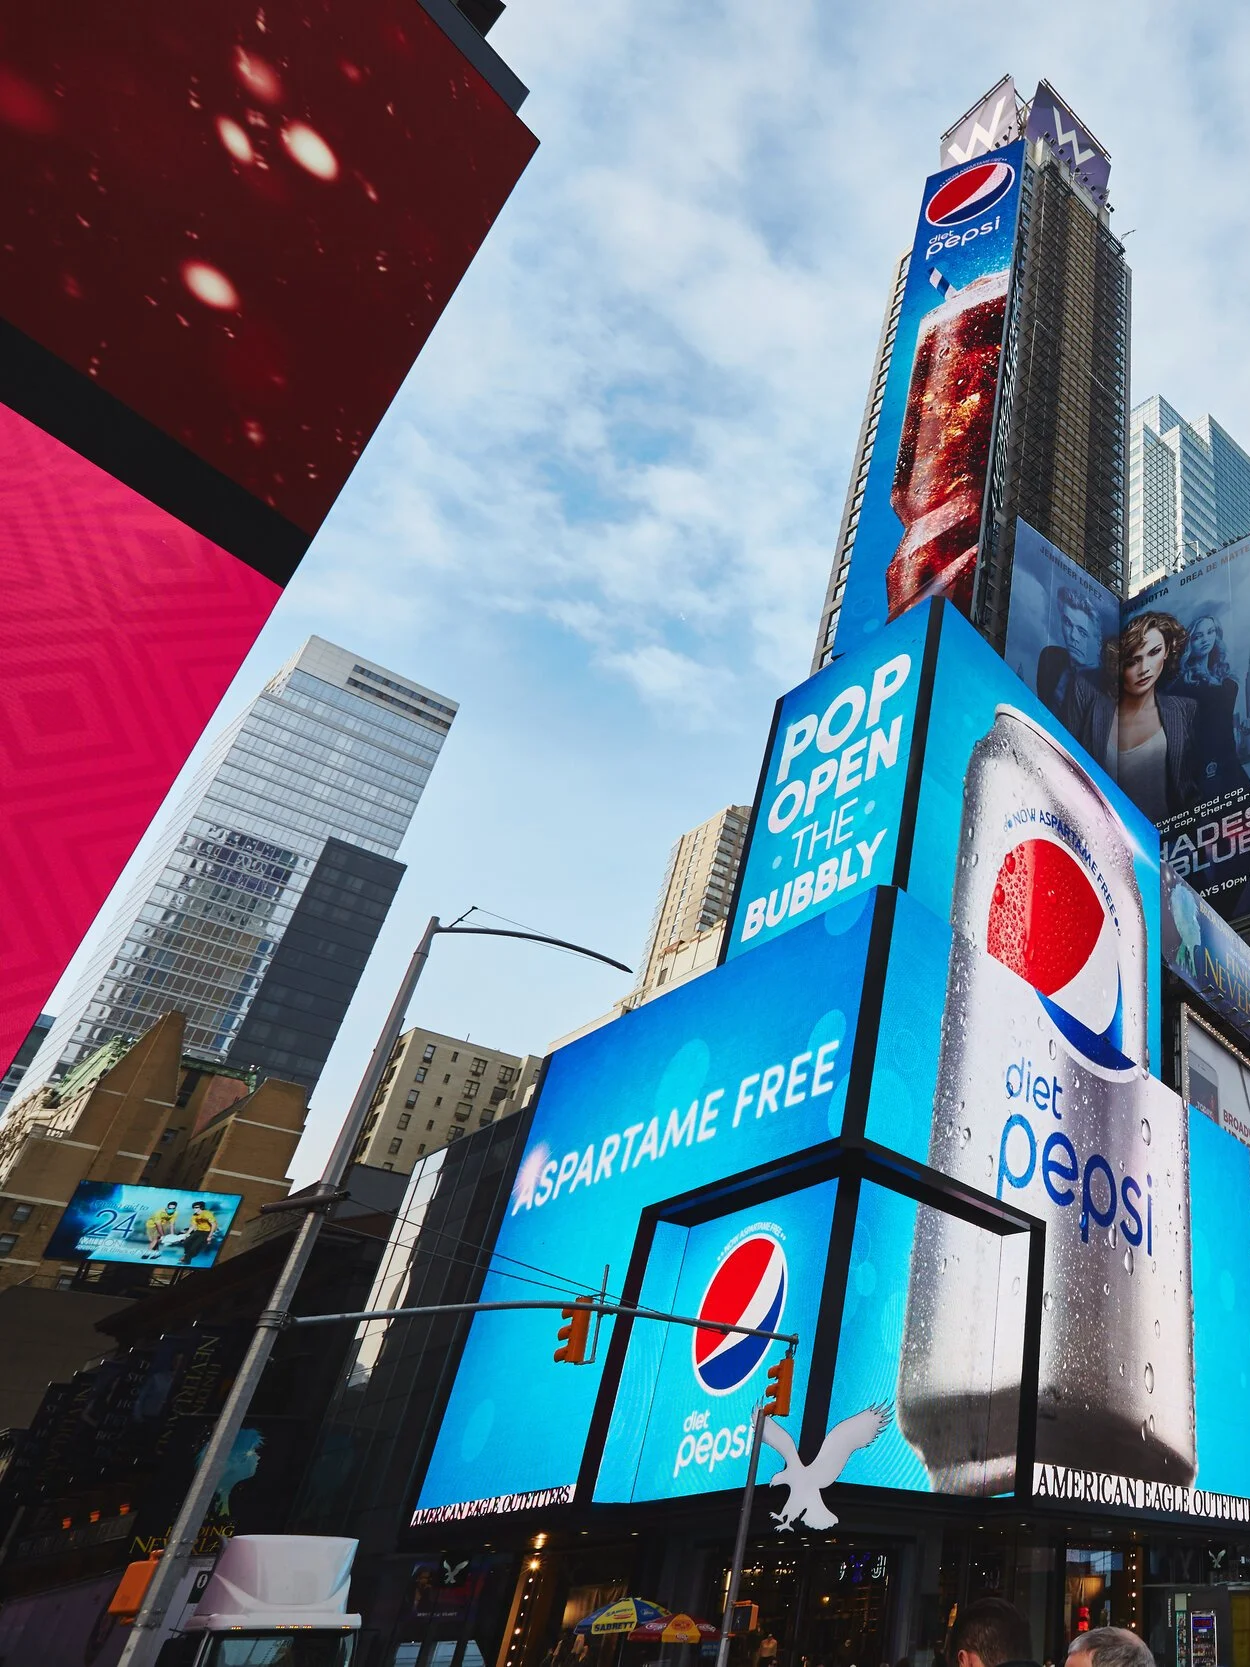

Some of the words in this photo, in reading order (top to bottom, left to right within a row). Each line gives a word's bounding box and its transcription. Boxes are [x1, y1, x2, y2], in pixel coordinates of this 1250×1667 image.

[1053, 105, 1096, 166] W
[925, 215, 1001, 261] pepsi
[928, 230, 954, 244] diet
[1039, 545, 1078, 582] JENNIFER
[1079, 576, 1103, 602] LOPEZ
[1179, 570, 1204, 588] DREA
[1205, 561, 1218, 575] DE
[775, 653, 912, 787] POP
[767, 714, 903, 834] OPEN
[1193, 794, 1220, 815] good
[1224, 786, 1245, 801] cop
[791, 797, 859, 869] THE
[1174, 816, 1197, 830] cop,
[1200, 802, 1233, 819] there
[740, 828, 888, 943] BUBBLY
[1012, 807, 1037, 828] NOW
[1039, 808, 1099, 877] ASPARTAME
[1096, 871, 1118, 917] FREE
[1220, 874, 1248, 892] 10PM
[1005, 1056, 1064, 1121] diet
[511, 1087, 725, 1217] ASPARTAME
[732, 1039, 840, 1129] FREE
[996, 1113, 1154, 1257] pepsi
[84, 1208, 138, 1240] 24
[683, 1410, 711, 1431] diet
[1037, 1464, 1139, 1508] AMERICAN
[1142, 1480, 1190, 1513] EAGLE
[594, 1621, 635, 1632] SABRETT
